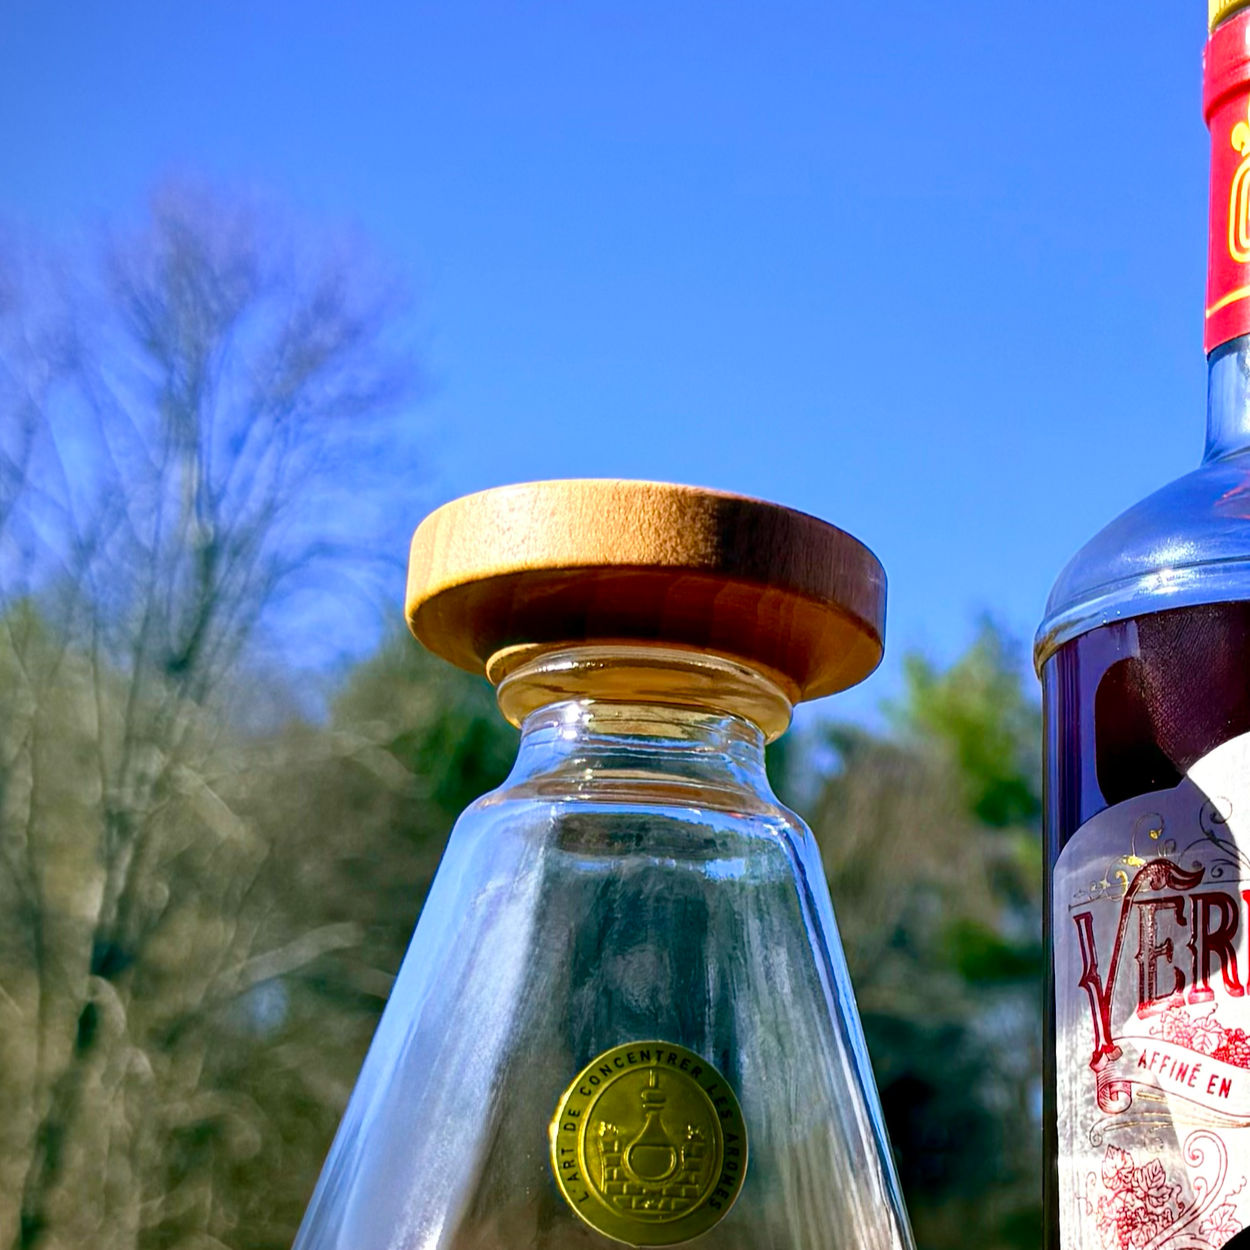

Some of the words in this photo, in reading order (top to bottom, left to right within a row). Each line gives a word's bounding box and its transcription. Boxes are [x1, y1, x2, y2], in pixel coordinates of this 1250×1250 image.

[580, 1050, 704, 1096] CONCENTRER
[1137, 1048, 1201, 1089] AFFINÉ
[1206, 1075, 1232, 1099] EN
[564, 1109, 581, 1132] DE
[706, 1083, 733, 1119] LES
[709, 1133, 740, 1210] AROMES
